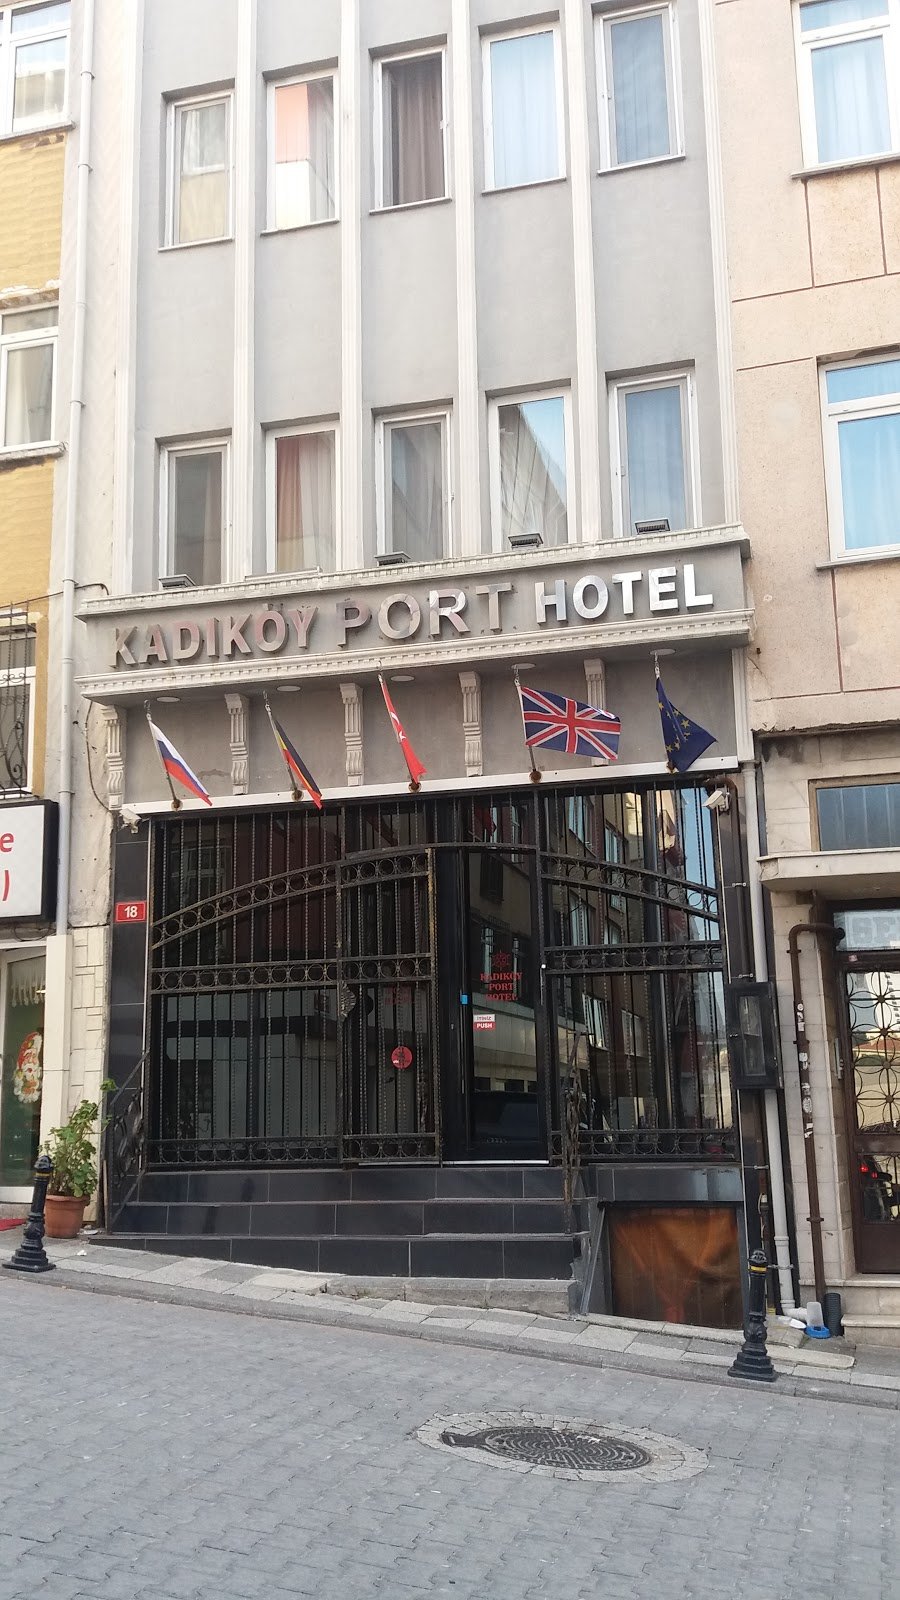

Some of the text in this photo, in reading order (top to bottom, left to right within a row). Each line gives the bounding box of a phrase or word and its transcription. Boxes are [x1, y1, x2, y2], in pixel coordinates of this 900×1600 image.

[111, 563, 713, 667] KADIKÖY PORT HOTEL
[124, 905, 138, 918] 18
[489, 983, 514, 991] PORT
[485, 993, 518, 1001] HOTEL
